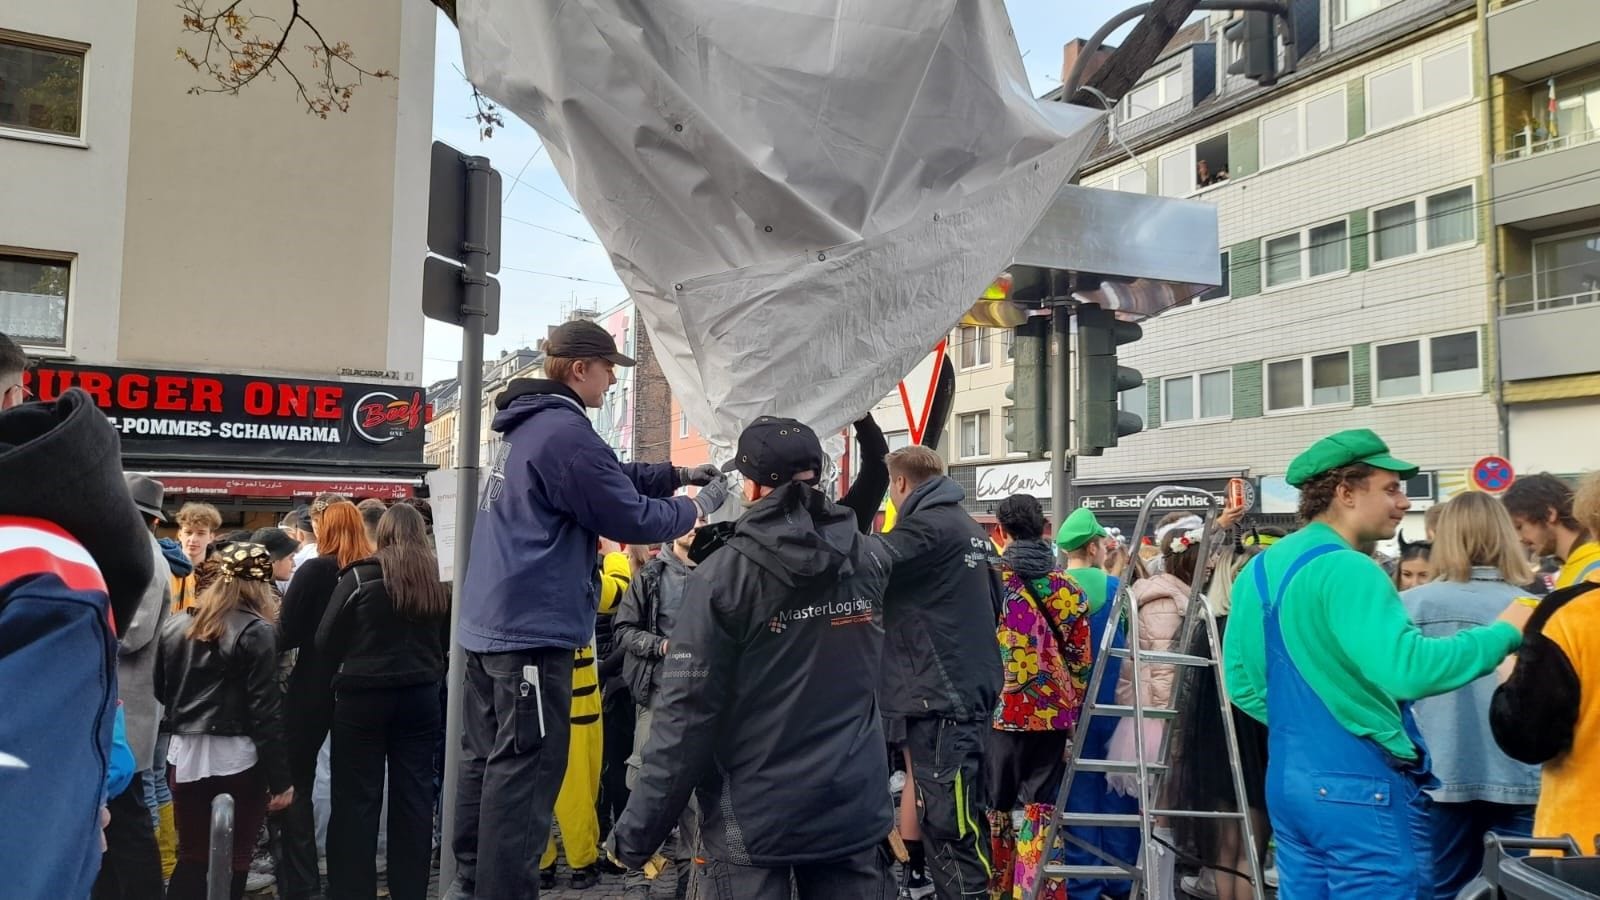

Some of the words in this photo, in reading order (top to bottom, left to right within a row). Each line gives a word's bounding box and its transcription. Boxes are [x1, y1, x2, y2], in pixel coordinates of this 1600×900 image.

[244, 382, 344, 419] ONE
[359, 391, 422, 431] Beef
[1082, 497, 1104, 508] der:
[780, 597, 873, 621] MasterLogistics
